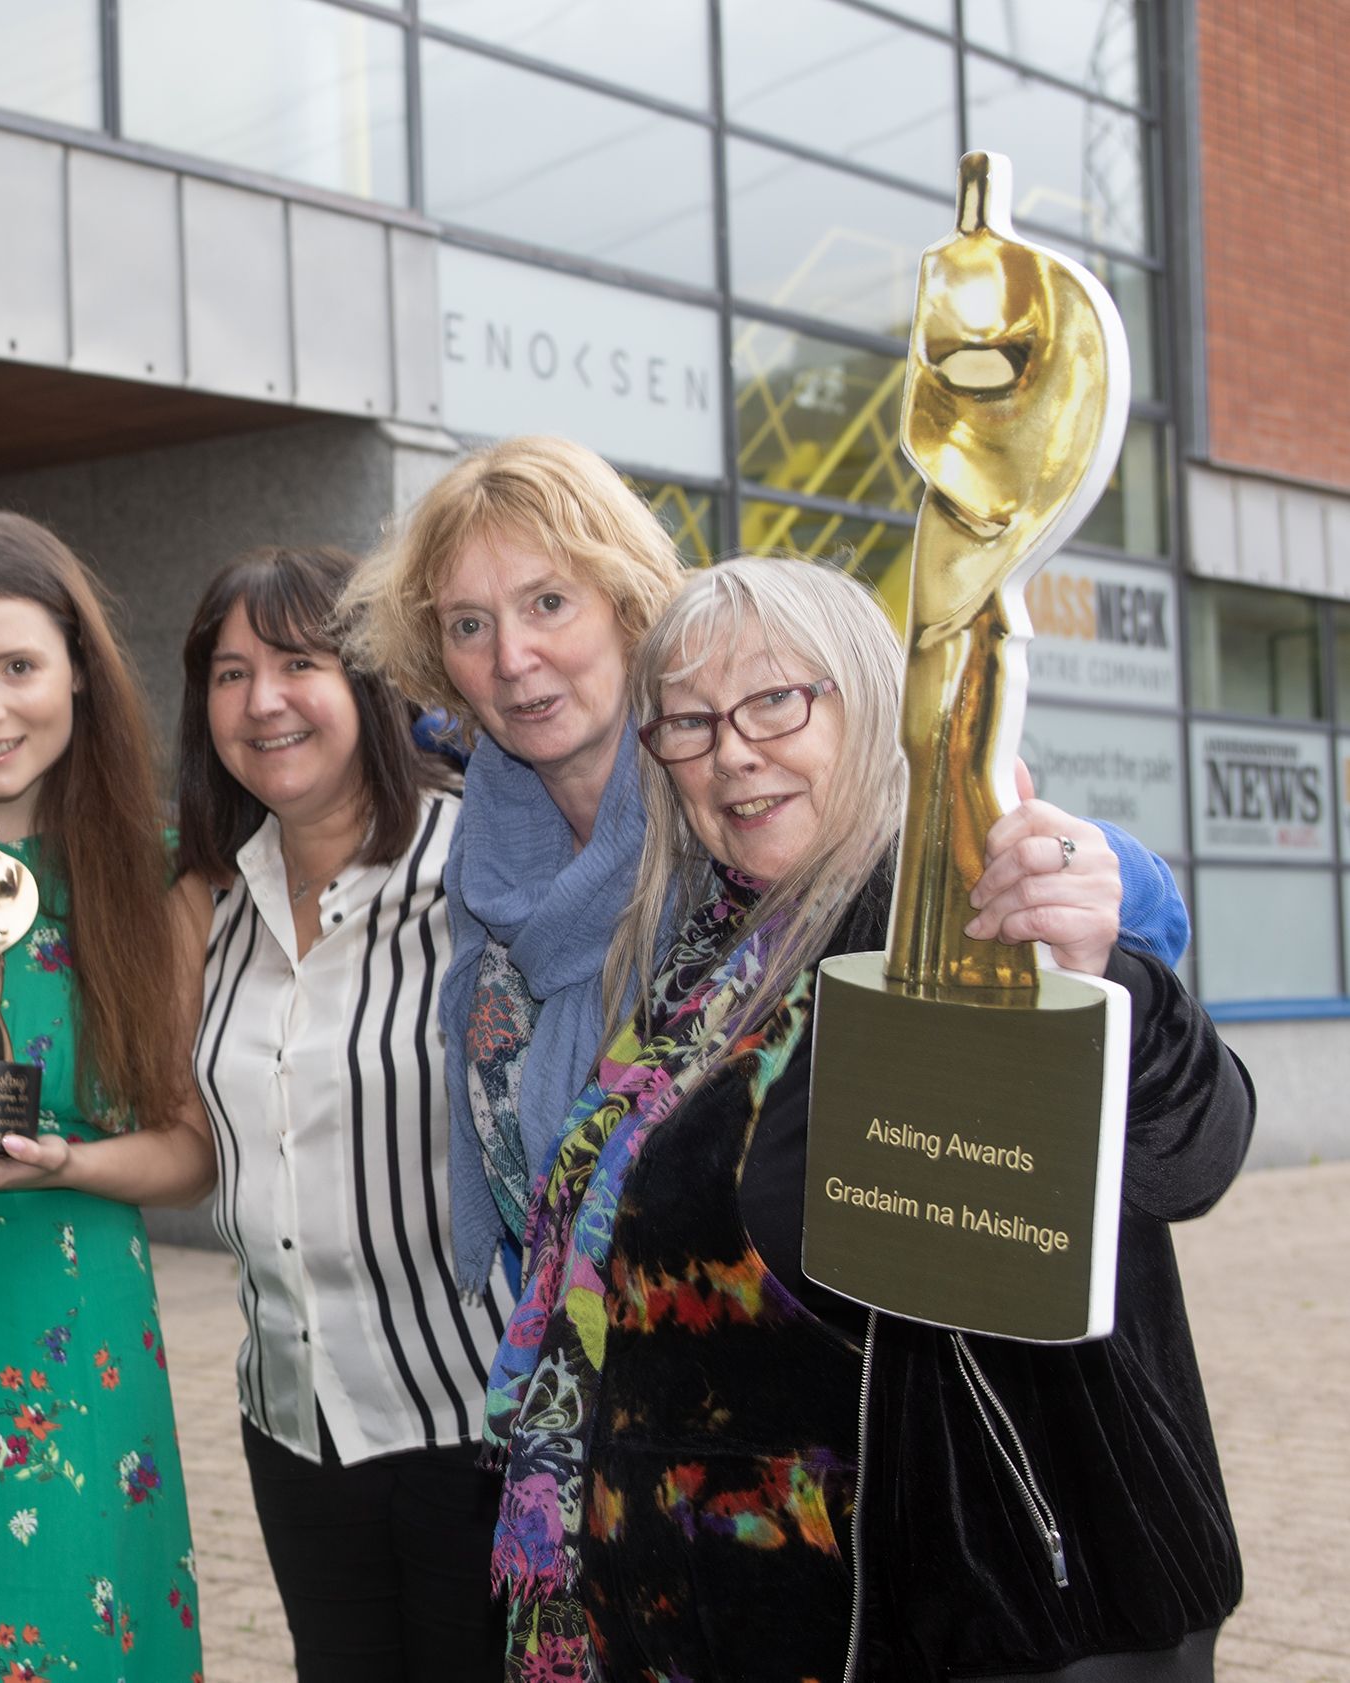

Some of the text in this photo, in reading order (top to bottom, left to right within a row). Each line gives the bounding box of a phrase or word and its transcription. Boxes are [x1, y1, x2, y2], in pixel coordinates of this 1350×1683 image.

[1206, 760, 1321, 824] NEWS
[866, 1118, 1035, 1173] Aisling Awards
[825, 1176, 1070, 1253] Gradaim na hAislinge
